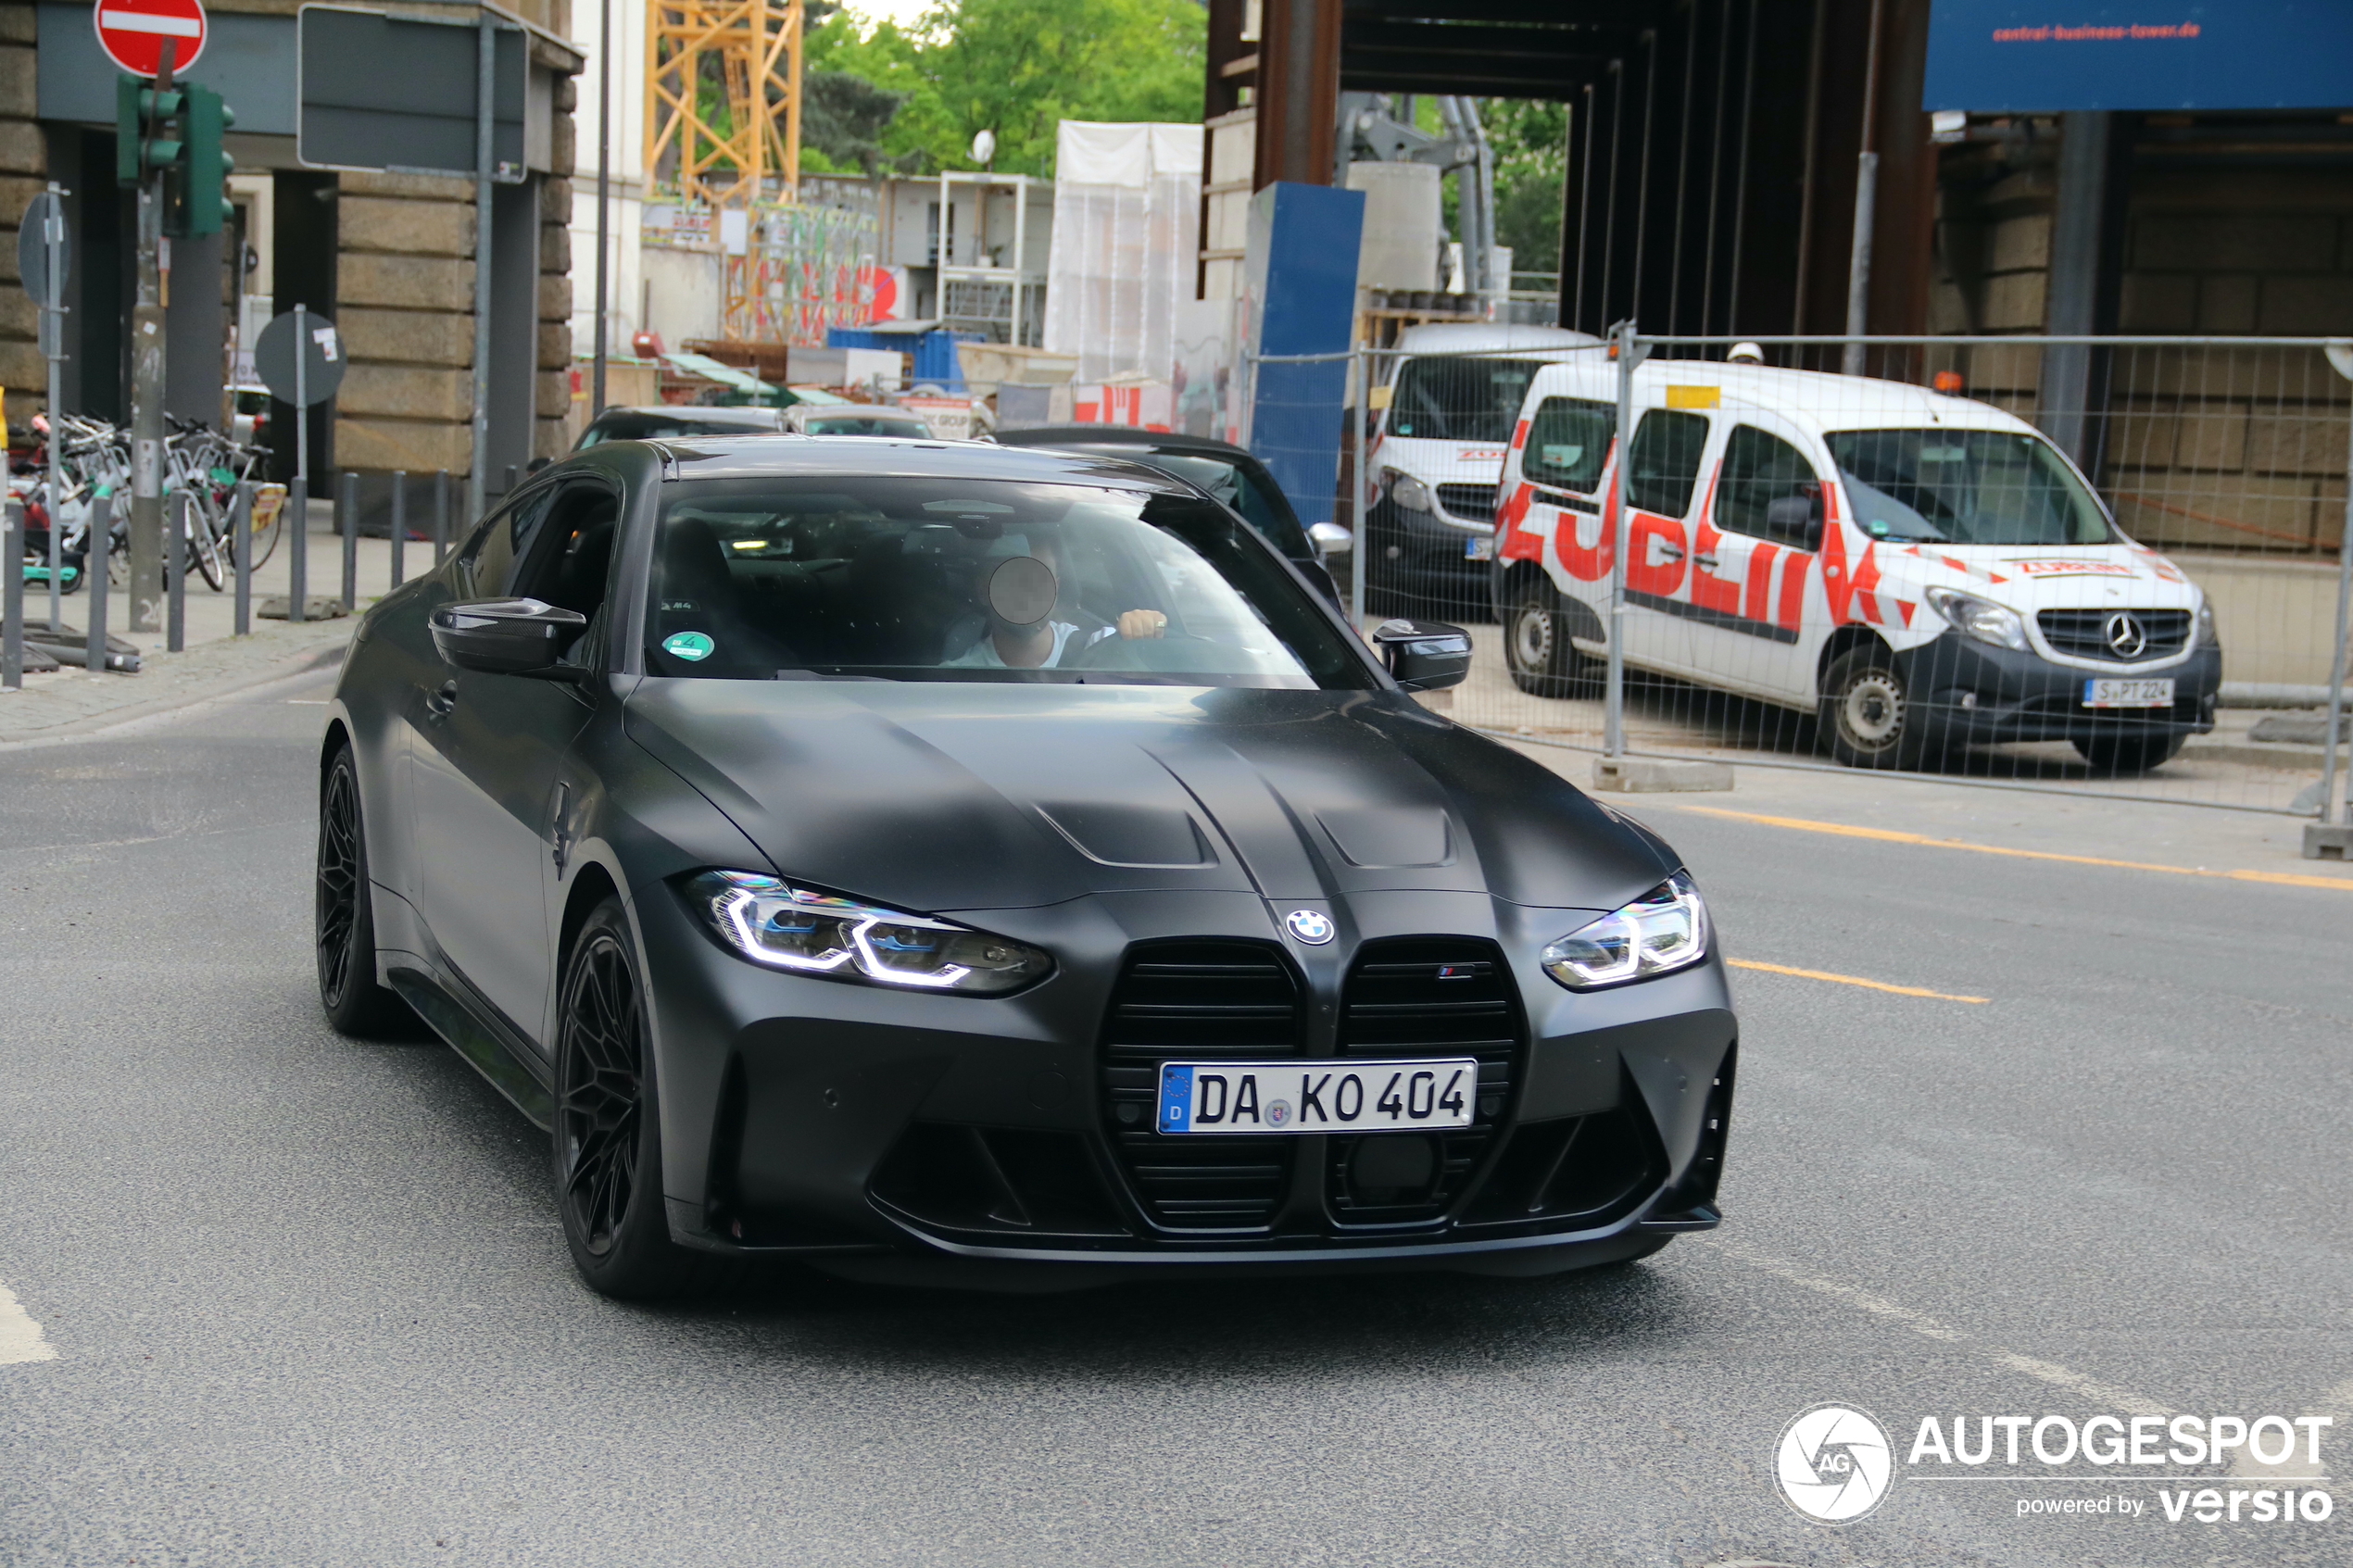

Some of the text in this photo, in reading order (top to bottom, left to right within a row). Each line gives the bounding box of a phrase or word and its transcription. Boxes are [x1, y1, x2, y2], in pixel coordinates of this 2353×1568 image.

[1993, 21, 2201, 42] central-business-tower.de
[682, 635, 696, 648] 4
[1169, 1069, 1465, 1124] D DA KO 404
